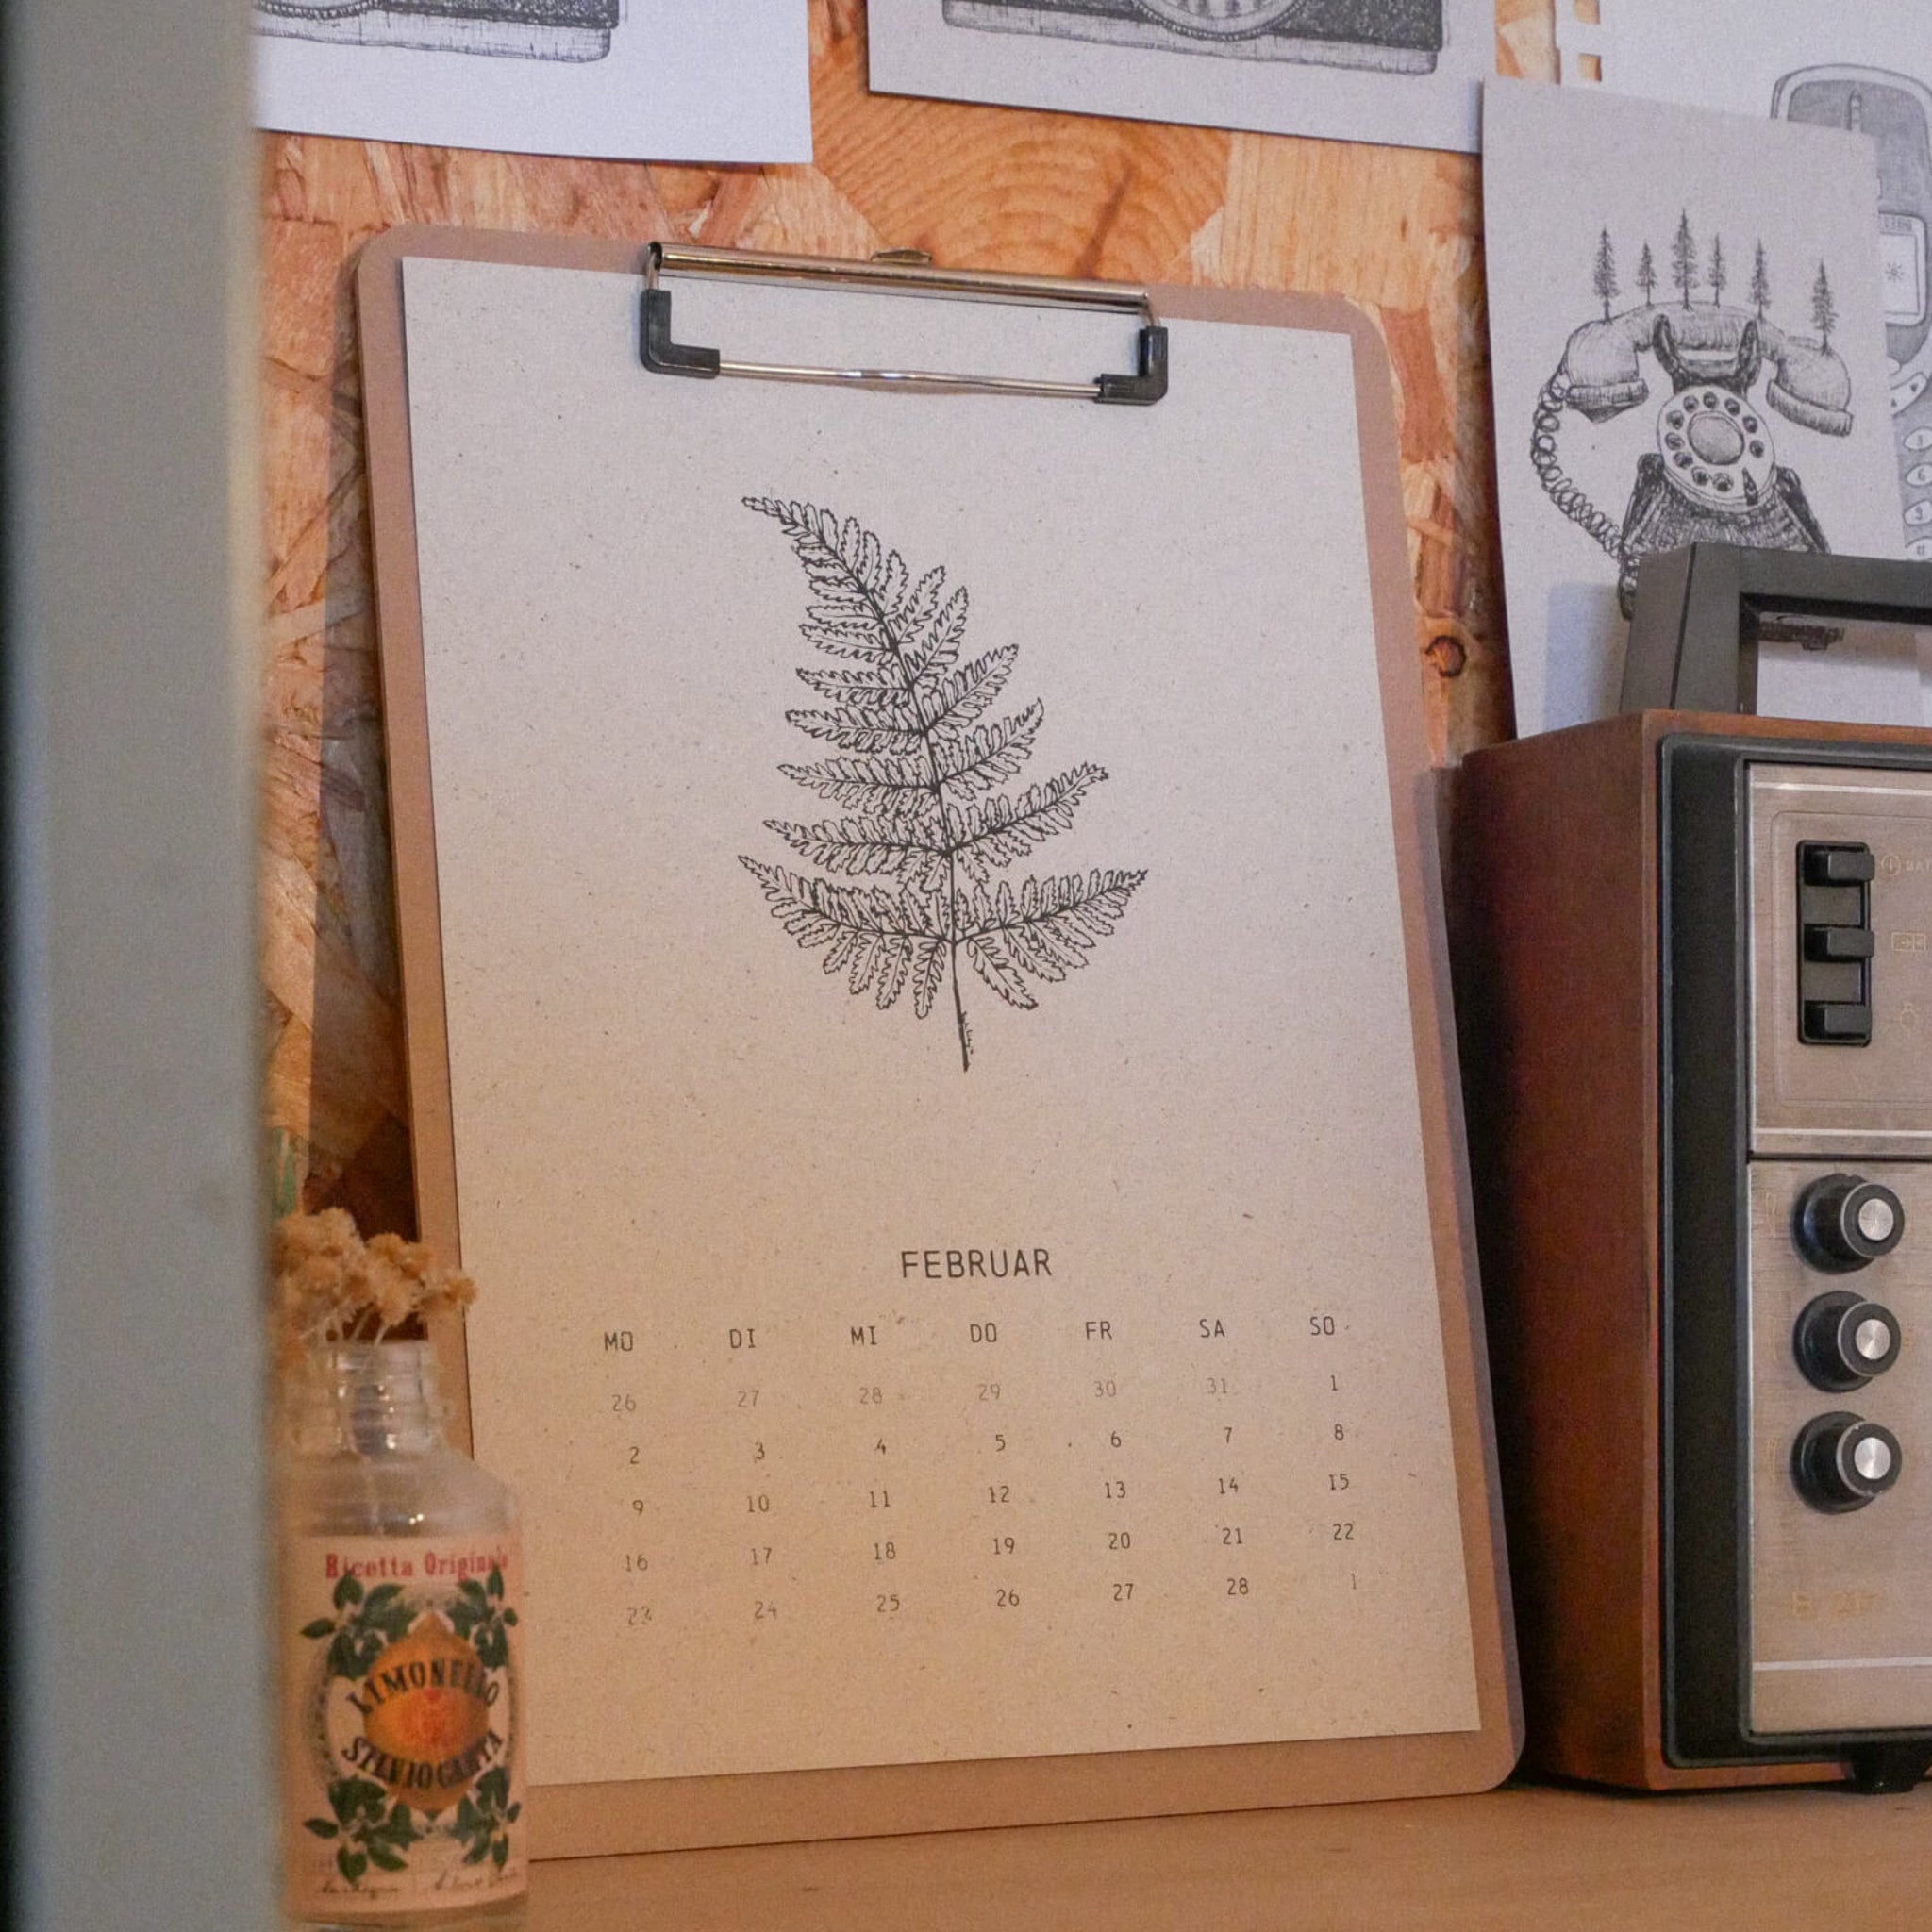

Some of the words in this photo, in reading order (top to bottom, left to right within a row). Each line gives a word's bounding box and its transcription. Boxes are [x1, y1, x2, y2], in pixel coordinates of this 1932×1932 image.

[900, 1248, 1053, 1279] FEBRUAR
[604, 1331, 634, 1352] MO
[729, 1328, 757, 1350] DI
[850, 1325, 877, 1346] MI
[970, 1322, 998, 1343] DO
[1085, 1320, 1112, 1340] FR
[1199, 1318, 1225, 1339] SA
[1309, 1316, 1335, 1336] SO
[612, 1394, 637, 1412] 26
[738, 1389, 759, 1408] 27
[859, 1387, 882, 1405] 28
[977, 1383, 1001, 1401] 29
[1094, 1380, 1117, 1398] 30
[1208, 1377, 1227, 1395] 31
[1330, 1374, 1339, 1391] 1
[629, 1446, 640, 1465] 2
[753, 1441, 765, 1463] 3
[874, 1438, 887, 1455] 4
[995, 1434, 1006, 1452] 5
[1110, 1430, 1122, 1448] 6
[1224, 1426, 1232, 1444] 7
[1334, 1424, 1344, 1441] 8
[632, 1500, 644, 1516] 9
[747, 1494, 770, 1513] 10
[869, 1490, 891, 1508] 11
[989, 1485, 1009, 1504] 12
[1105, 1480, 1126, 1499] 13
[1218, 1477, 1239, 1495] 14
[1328, 1474, 1350, 1491] 15
[325, 1552, 413, 1578] Ricetta
[625, 1554, 648, 1572] 16
[751, 1547, 772, 1566] 17
[874, 1541, 896, 1561] 18
[993, 1537, 1015, 1555] 19
[1108, 1532, 1131, 1550] 20
[1223, 1527, 1243, 1545] 21
[1333, 1521, 1355, 1541] 22
[627, 1606, 652, 1625] 23
[755, 1601, 777, 1620] 24
[877, 1594, 900, 1613] 25
[996, 1589, 1020, 1607] 26
[1113, 1583, 1134, 1602] 27
[1227, 1577, 1249, 1596] 28
